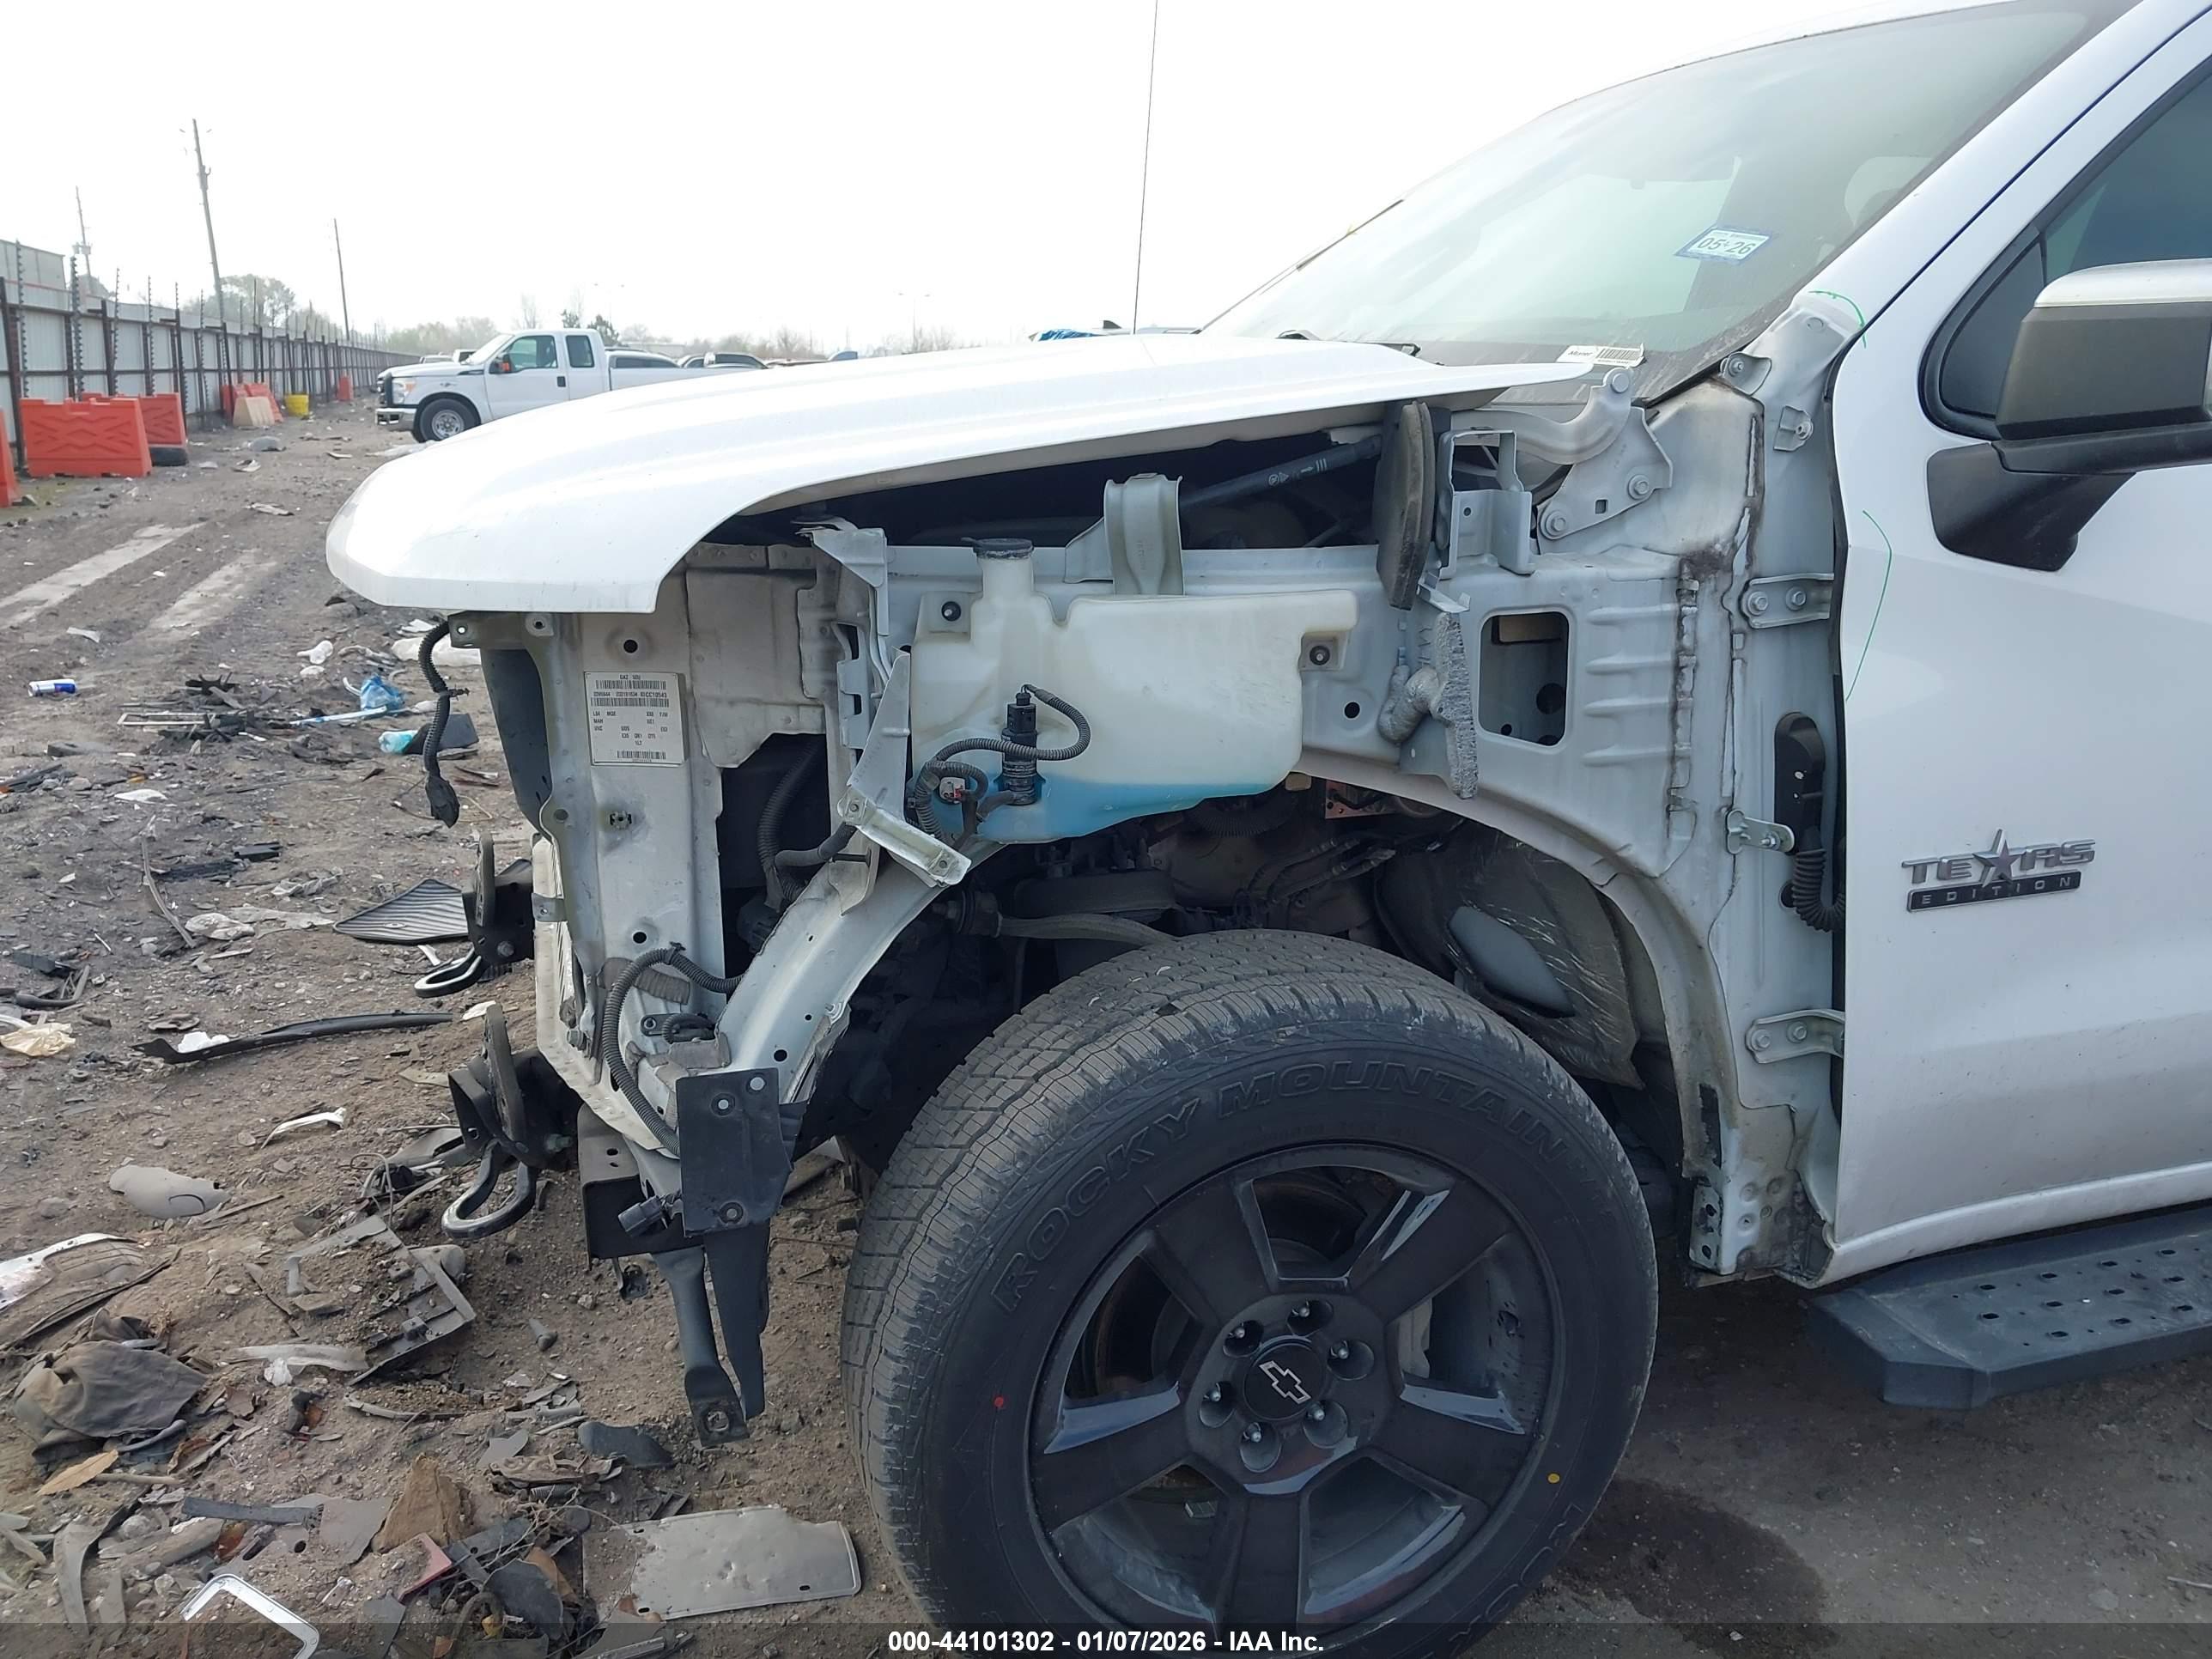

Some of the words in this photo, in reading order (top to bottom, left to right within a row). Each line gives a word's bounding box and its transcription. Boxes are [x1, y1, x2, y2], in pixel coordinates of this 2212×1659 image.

[1698, 237, 1726, 250] 05
[1724, 241, 1756, 255] 26
[1922, 877, 2071, 905] EDITION
[991, 1097, 1201, 1312] ROCKY
[1217, 1060, 1570, 1163] MOUNTAIN
